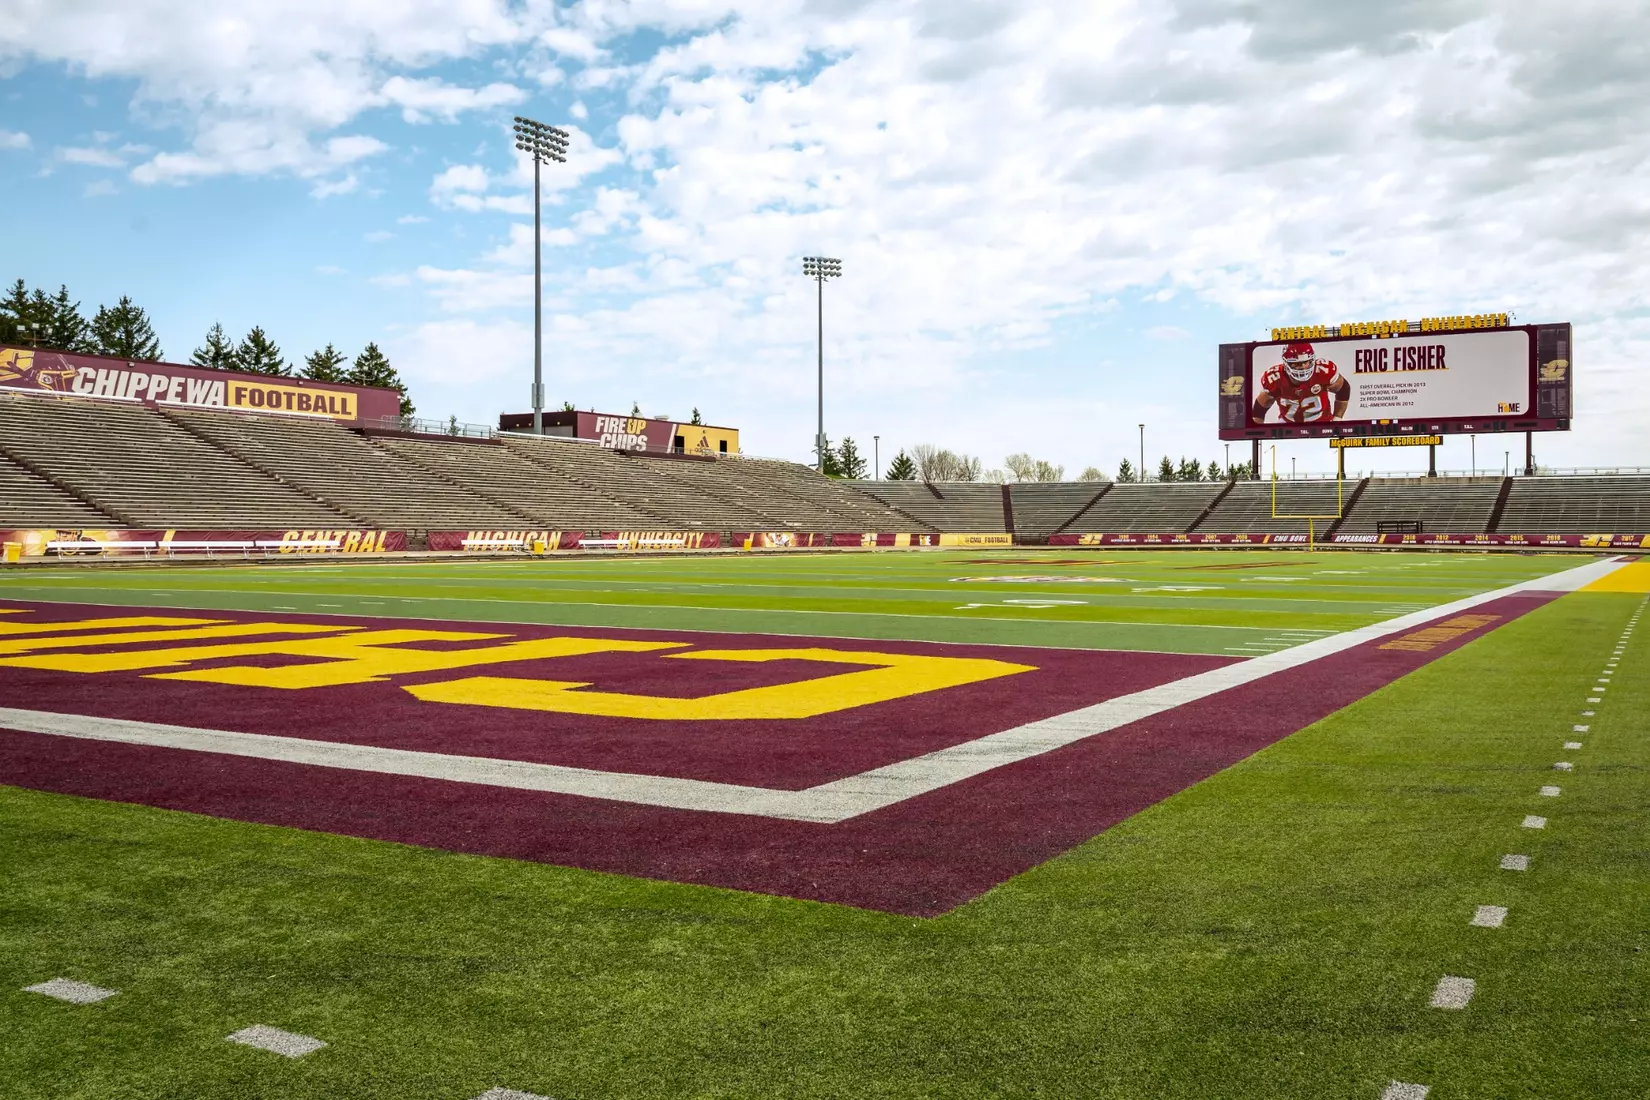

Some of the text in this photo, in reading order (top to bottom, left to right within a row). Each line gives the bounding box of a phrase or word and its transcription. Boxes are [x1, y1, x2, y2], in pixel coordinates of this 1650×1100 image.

[1271, 312, 1508, 340] CENTRAL MICHIGAN UNIVERSITY
[1355, 345, 1446, 373] ERIC FISHER
[72, 366, 353, 416] CHIPPEWA FOOTBALL
[1280, 395, 1323, 422] 72
[595, 416, 647, 435] FIRE UP
[599, 433, 648, 451] CHIPS
[1365, 438, 1390, 446] FAMILY
[1392, 436, 1440, 446] SCOREBOARD
[280, 530, 388, 553] CENTRAL
[463, 531, 562, 551] MICHIGAN
